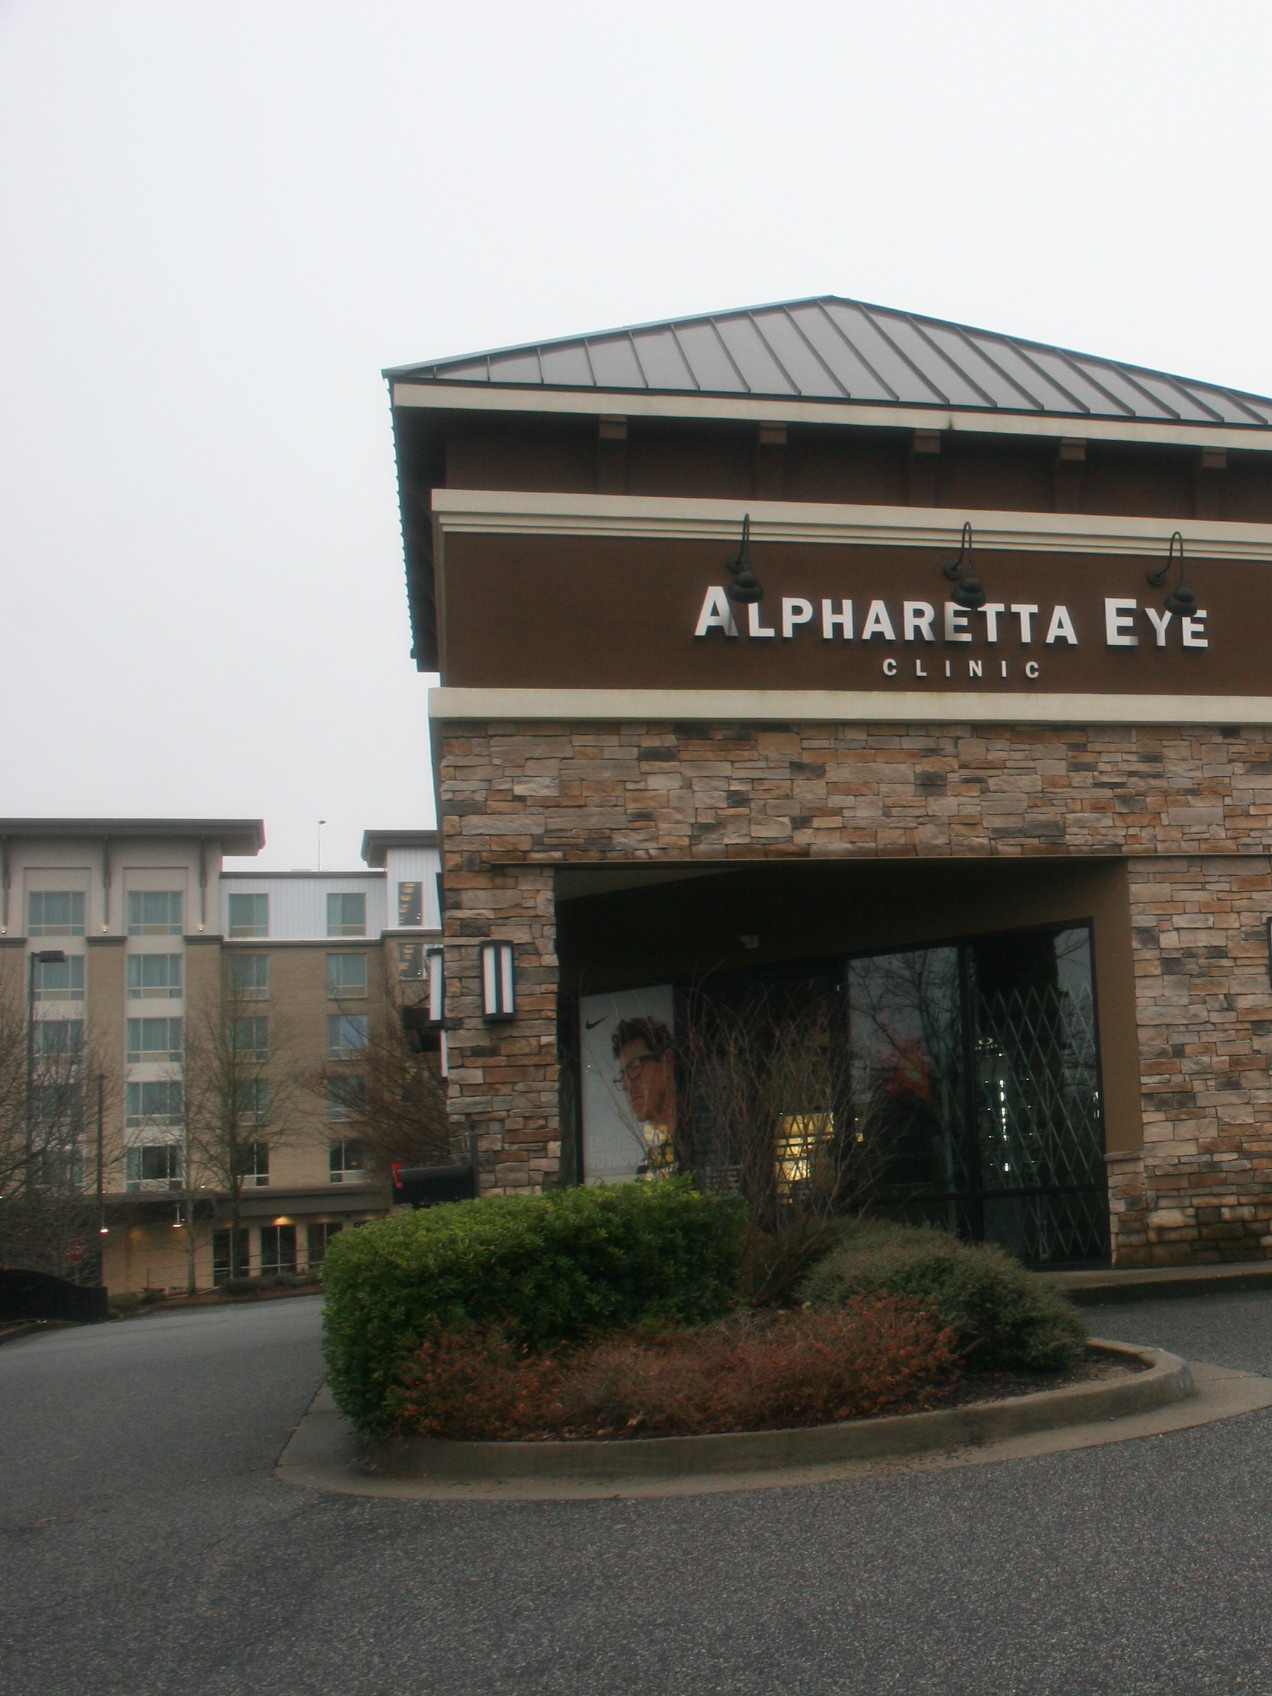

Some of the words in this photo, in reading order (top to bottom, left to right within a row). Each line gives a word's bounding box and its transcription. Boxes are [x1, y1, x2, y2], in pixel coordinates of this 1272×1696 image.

[694, 586, 1078, 644] ALPHARETTA
[1104, 597, 1209, 648] EYE
[882, 658, 1040, 679] CLINIC
